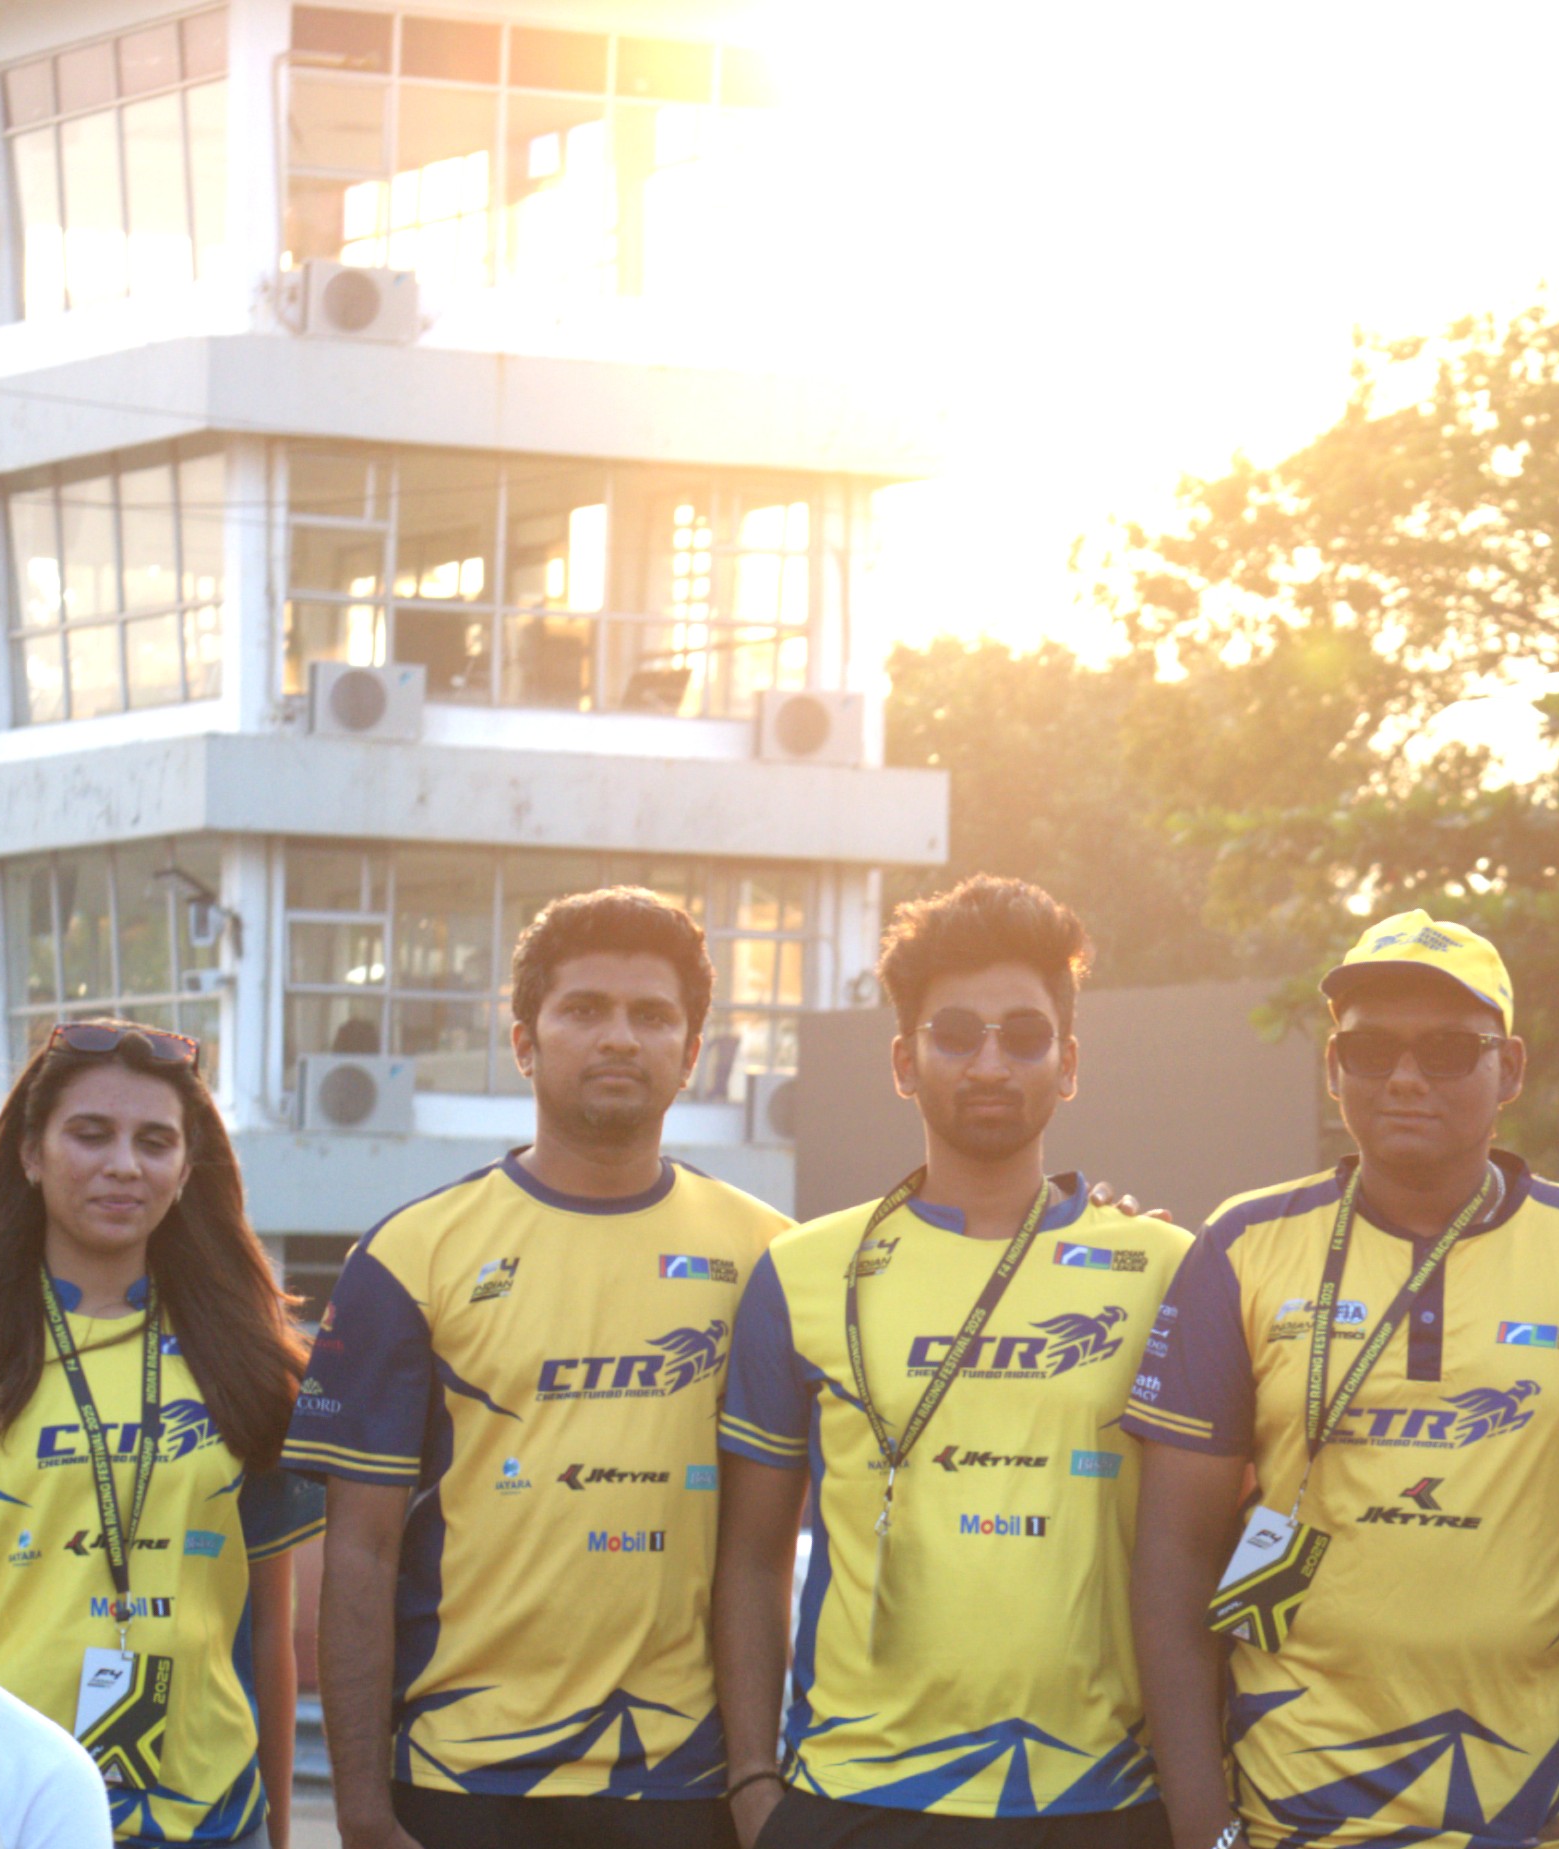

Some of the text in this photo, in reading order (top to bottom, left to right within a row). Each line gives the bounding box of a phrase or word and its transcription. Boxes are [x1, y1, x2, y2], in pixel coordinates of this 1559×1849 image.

[477, 1257, 520, 1284] F4
[907, 1336, 1048, 1369] CTR
[939, 1334, 970, 1382] FESTIVAL
[964, 1307, 987, 1336] 2025
[1312, 1310, 1331, 1364] FESTIVAL
[538, 1355, 664, 1393] CTR
[962, 1370, 1047, 1379] TURBO RIDERS
[1344, 1321, 1393, 1395] CHAMPIONSHIP
[535, 1389, 667, 1402] CHENNAI TURBO RIDERS
[1309, 1366, 1322, 1405] RACING
[588, 1531, 664, 1552] Mobil 1
[960, 1514, 1043, 1536] Mobil 1
[1300, 1535, 1330, 1579] 2025
[153, 1659, 171, 1705] 2025
